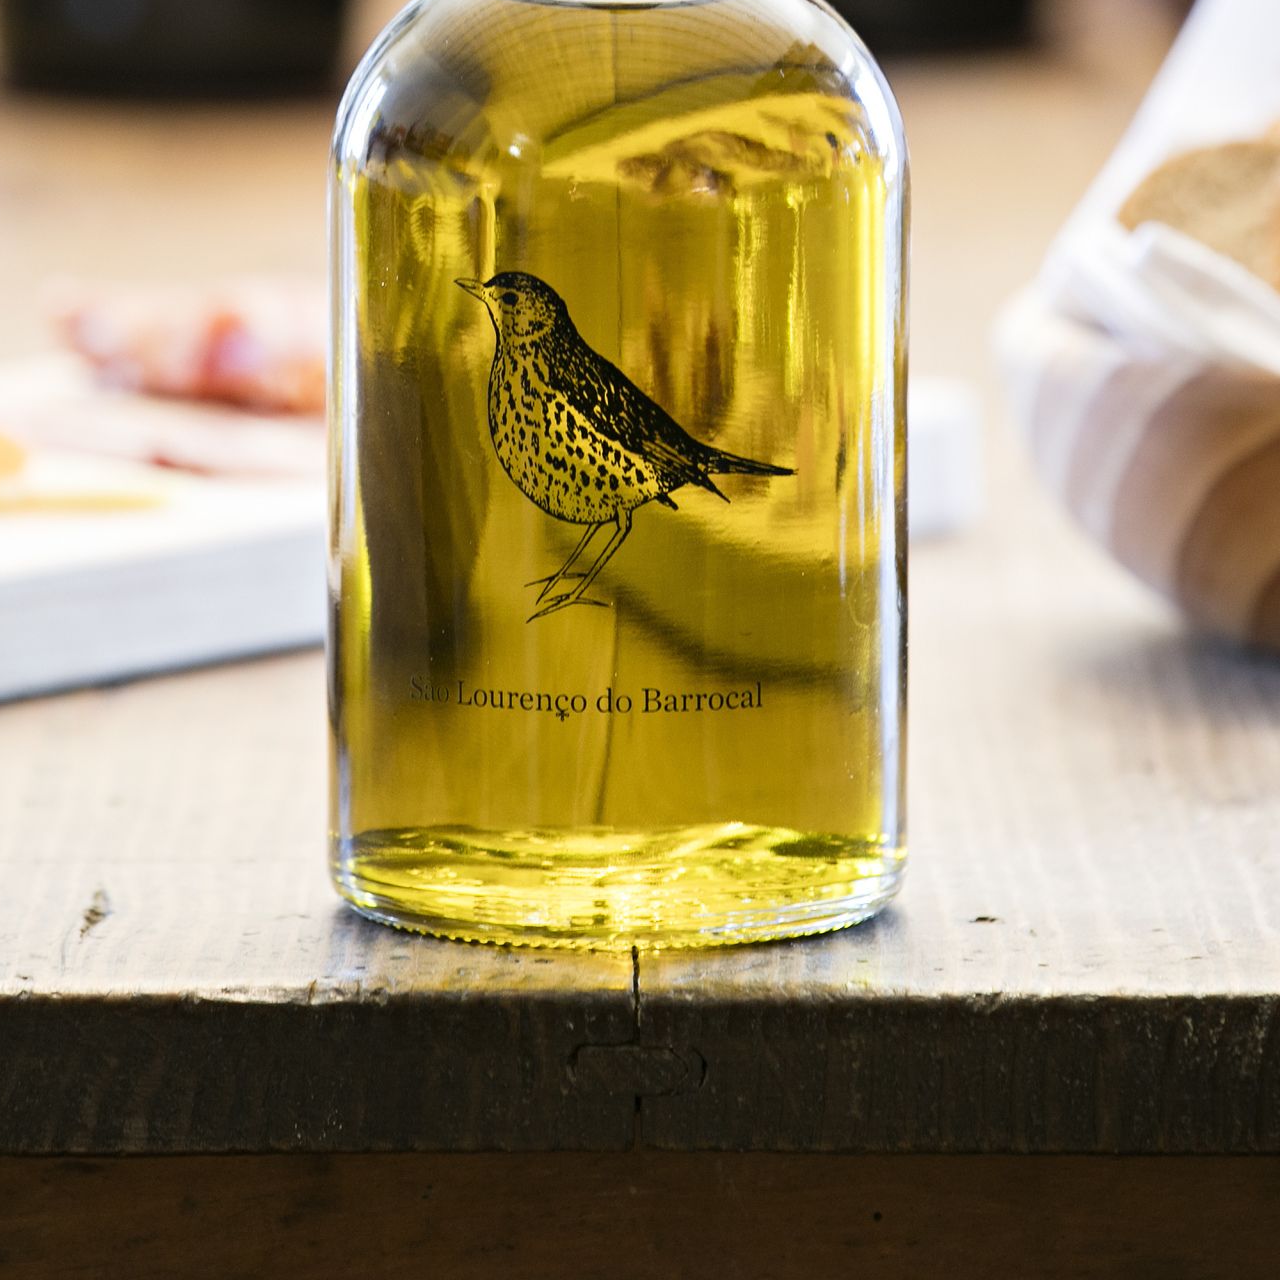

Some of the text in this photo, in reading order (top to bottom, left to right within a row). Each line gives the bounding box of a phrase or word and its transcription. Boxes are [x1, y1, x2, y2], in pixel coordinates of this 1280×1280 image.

[457, 680, 588, 722] Lourenço
[596, 687, 633, 715] do
[642, 682, 763, 714] Barrocal
